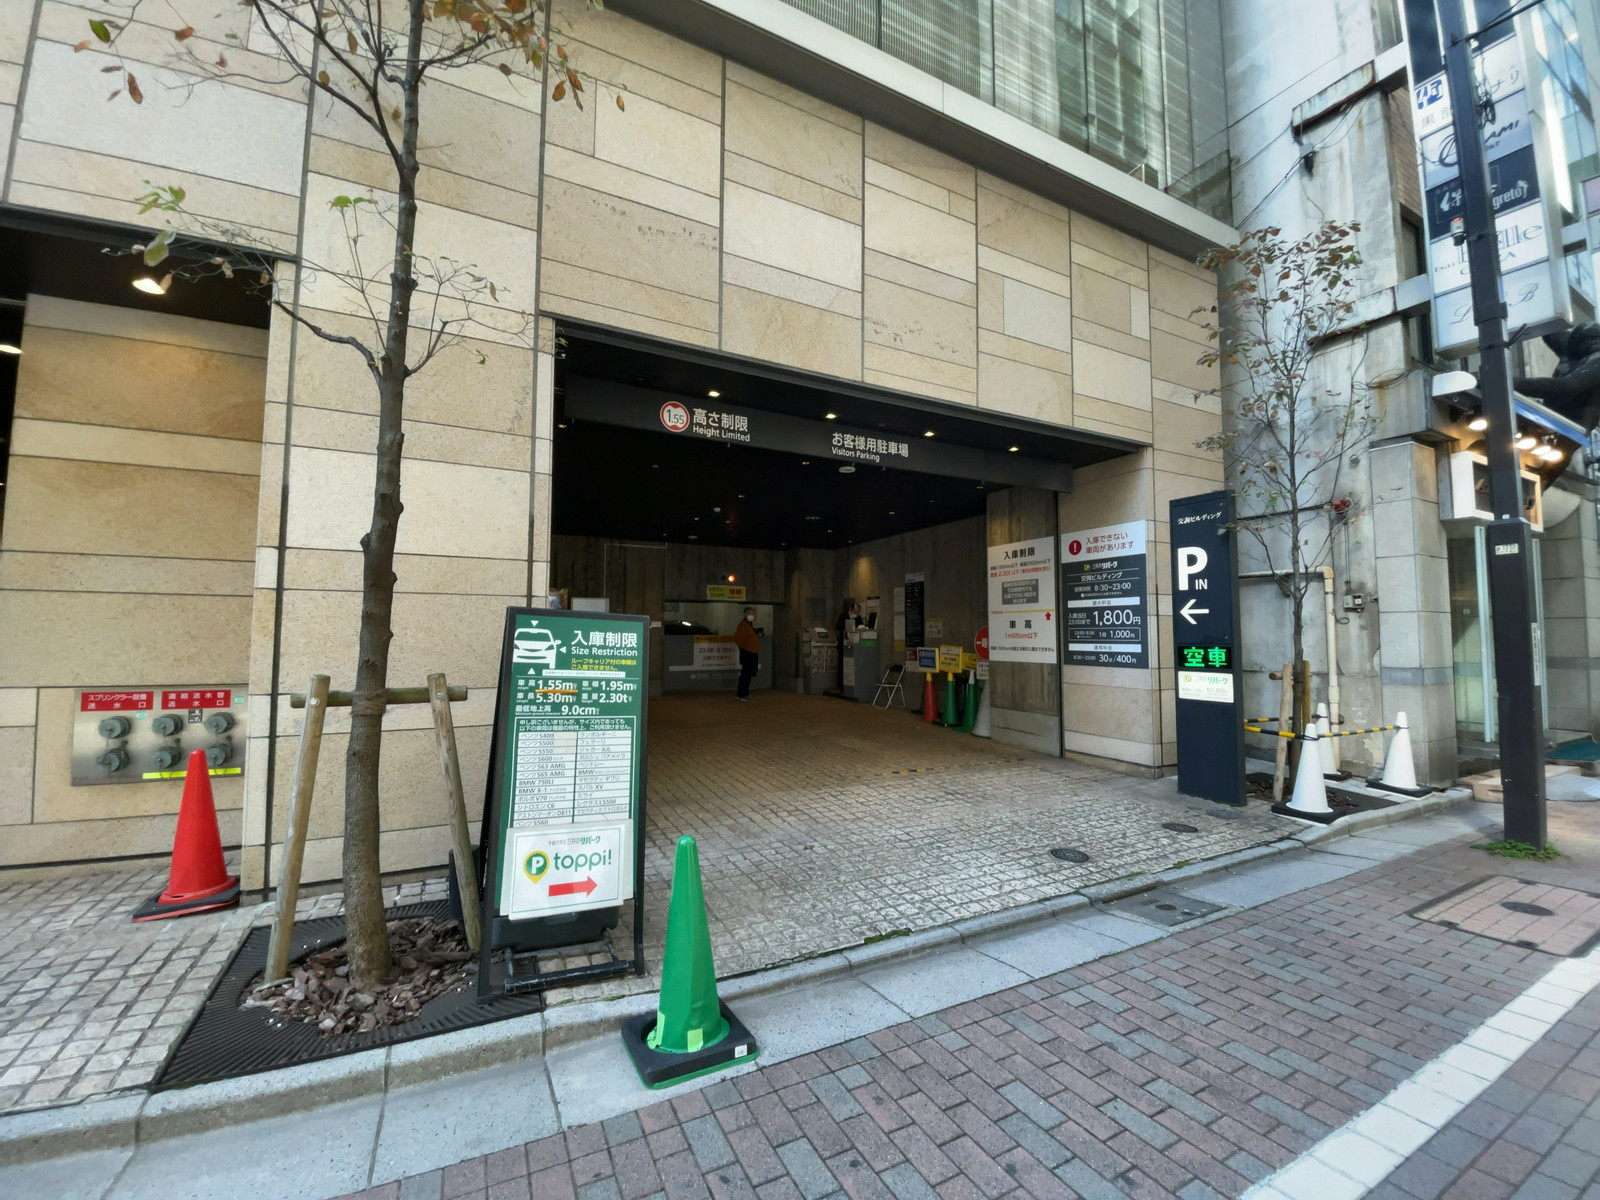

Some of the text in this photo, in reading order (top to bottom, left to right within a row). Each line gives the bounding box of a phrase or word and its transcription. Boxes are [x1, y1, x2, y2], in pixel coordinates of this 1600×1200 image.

[666, 408, 684, 425] 1.55
[693, 408, 748, 432] 高さ制限
[693, 425, 750, 442] Height Limited
[832, 432, 908, 458] お客様用駐車場
[832, 446, 880, 462] Visitors Parking
[1086, 532, 1128, 545] 入庫できない
[1004, 547, 1035, 560] 入庫制限
[1086, 541, 1134, 553] 車両があります
[1177, 546, 1208, 591] P
[1195, 578, 1208, 590] IN
[1009, 619, 1032, 629] 車高
[1093, 609, 1141, 626] 1,800円
[571, 630, 637, 648] 入庫制限
[592, 648, 637, 656] Restriction
[1184, 647, 1227, 668] 空車
[537, 680, 573, 690] 1.55m
[600, 681, 634, 690] 1.95m
[536, 693, 573, 703] 5.30m
[599, 693, 628, 703] 2.30t
[562, 705, 596, 715] 9.0cm
[554, 849, 612, 872] toppi!
